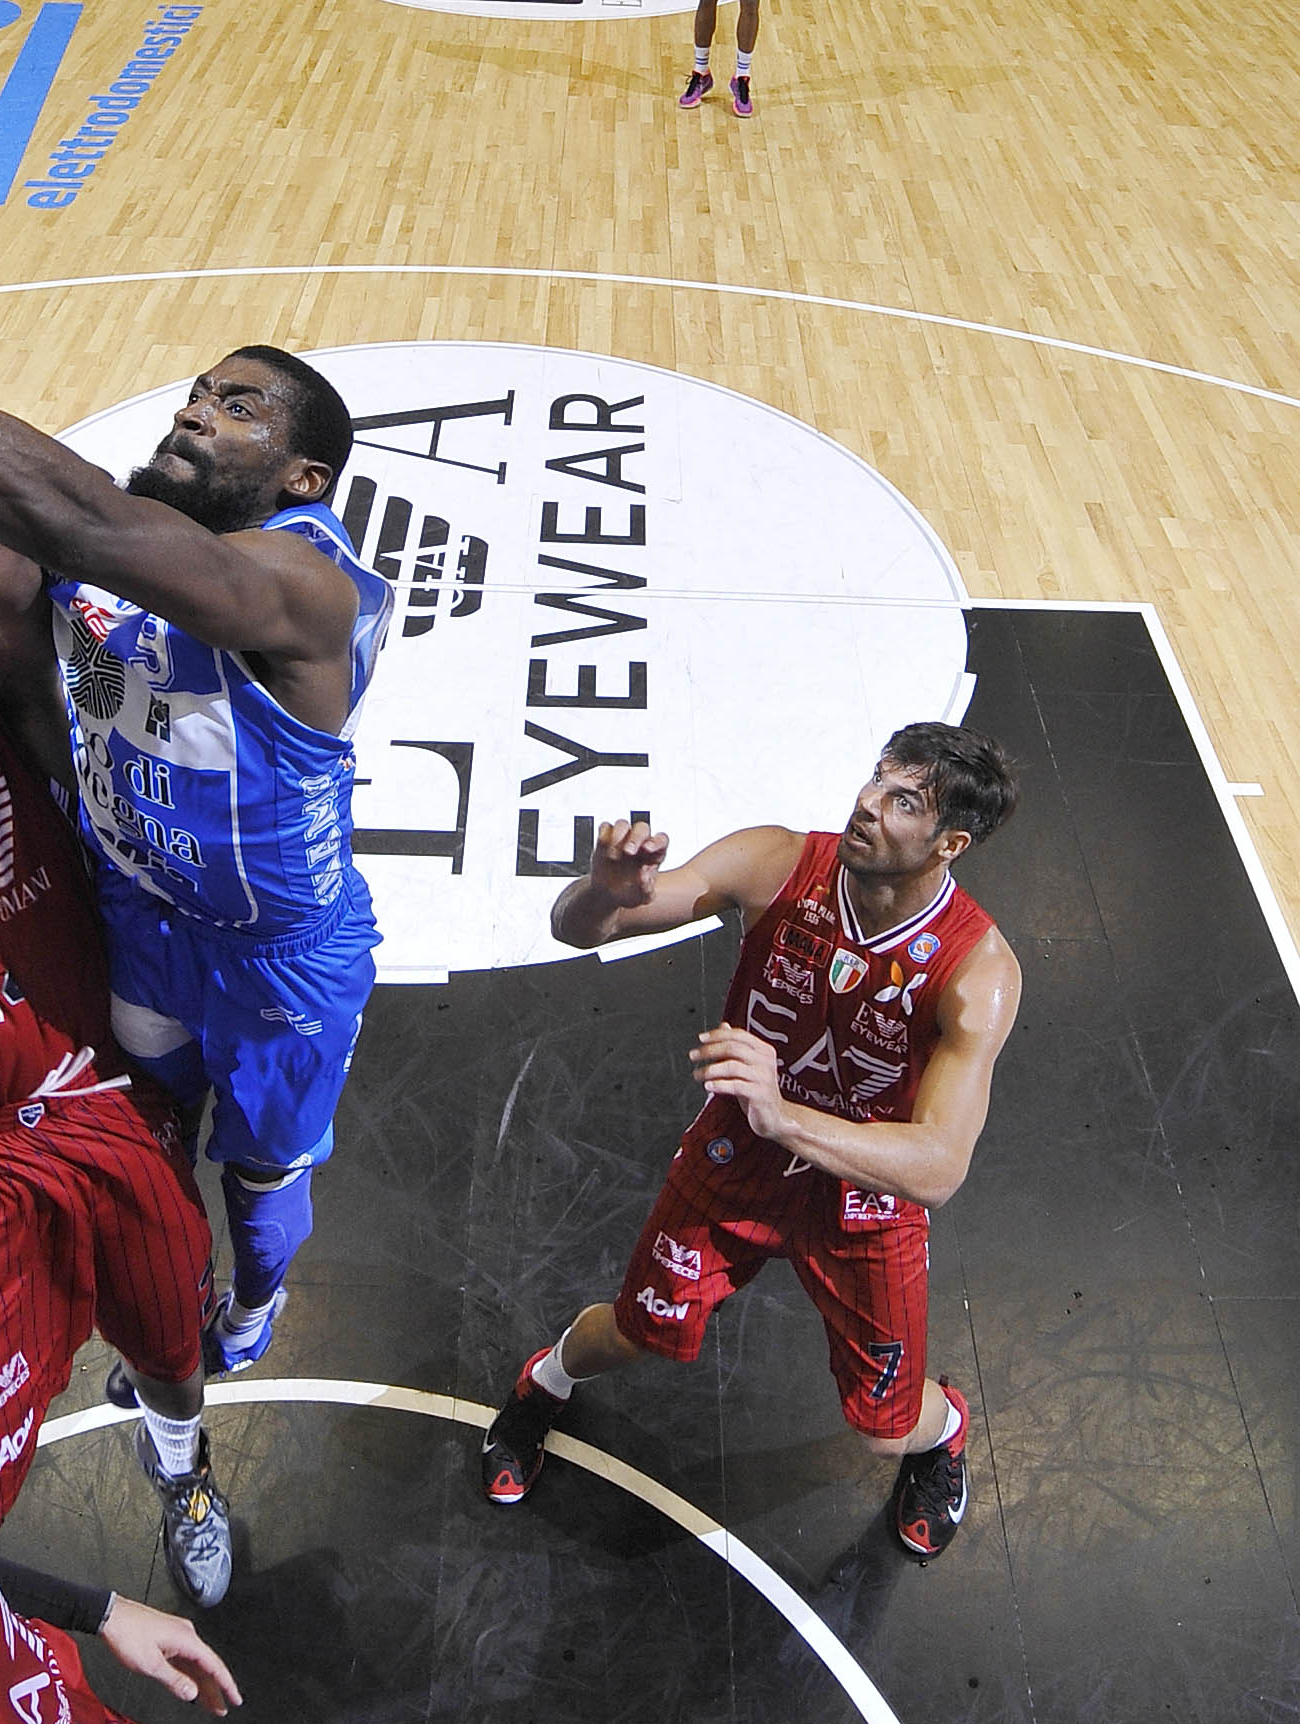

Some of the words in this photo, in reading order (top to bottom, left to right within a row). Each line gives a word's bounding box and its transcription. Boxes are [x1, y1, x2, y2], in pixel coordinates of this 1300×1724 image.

[25, 3, 204, 209] elettrodomestici
[515, 393, 651, 877] EYEWEAR
[122, 755, 176, 810] di
[844, 1189, 895, 1216] EA7
[868, 1341, 904, 1399] 7
